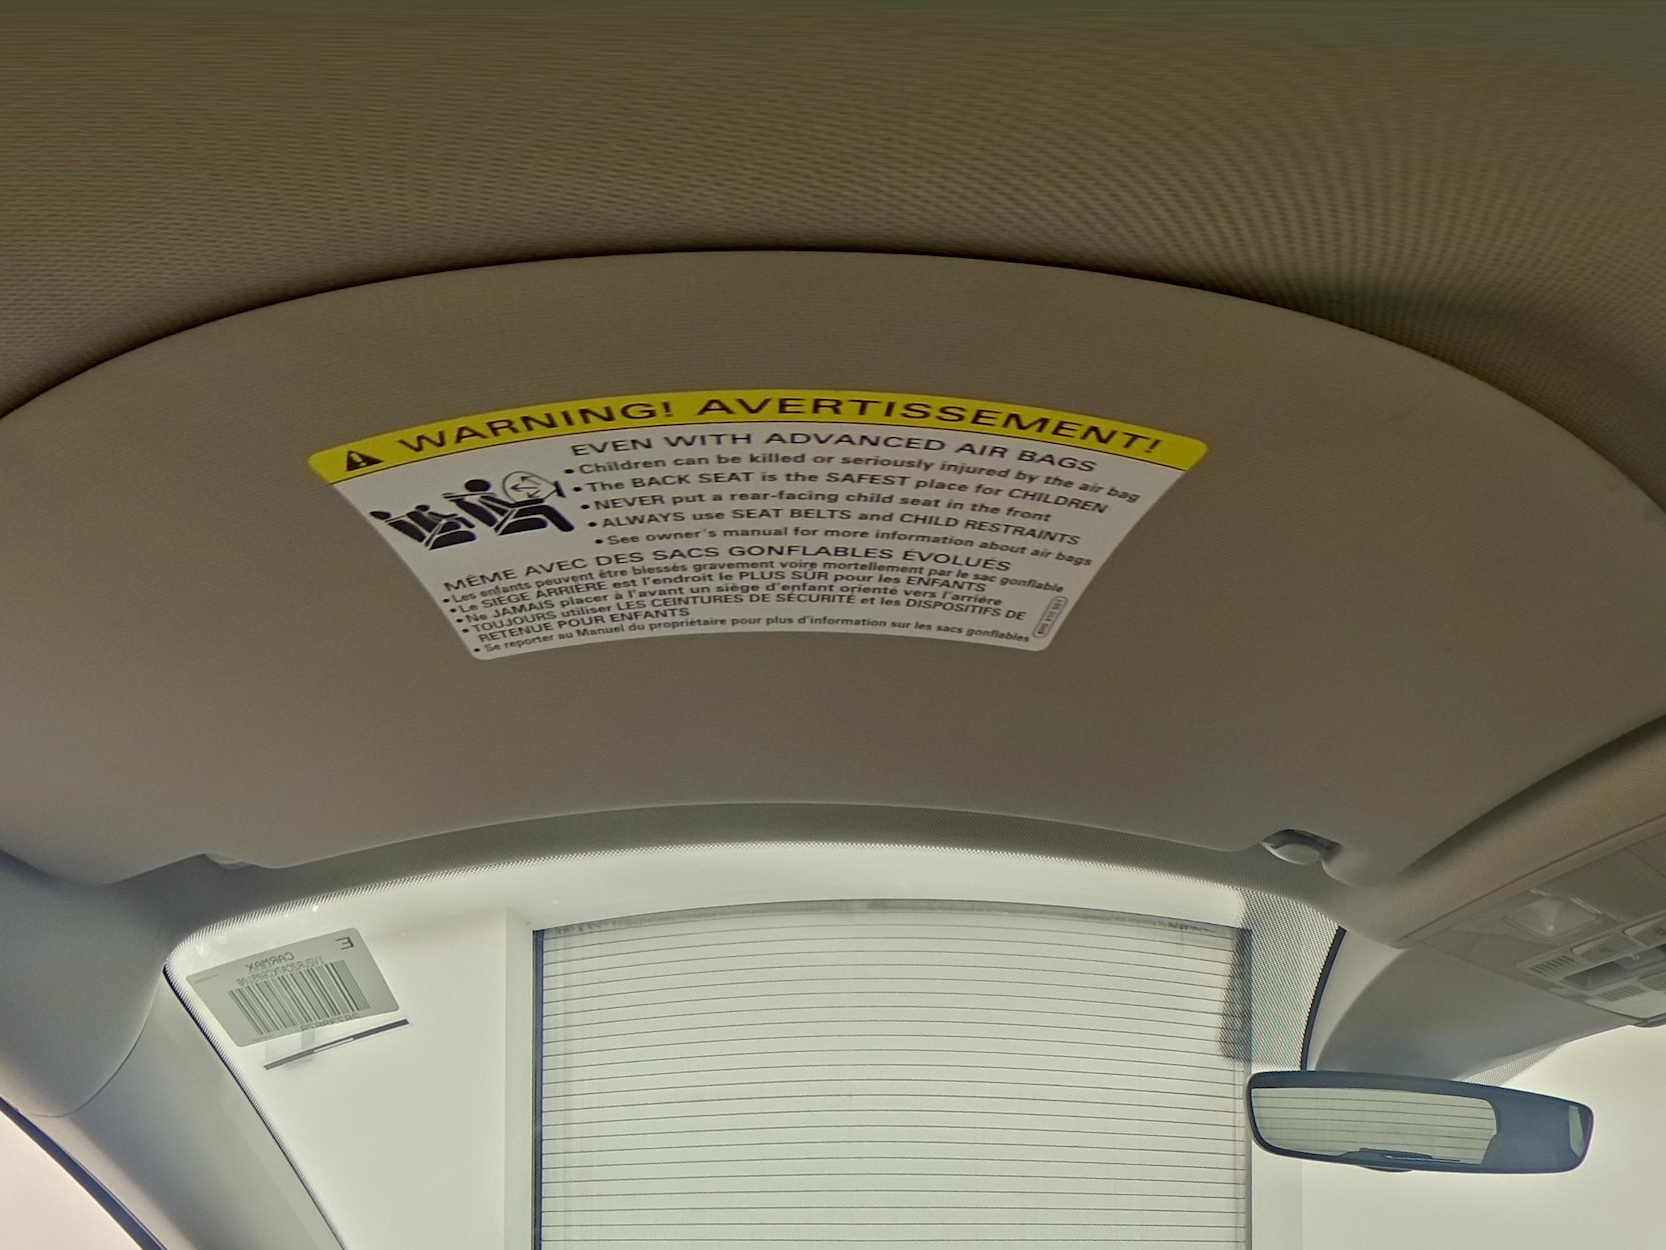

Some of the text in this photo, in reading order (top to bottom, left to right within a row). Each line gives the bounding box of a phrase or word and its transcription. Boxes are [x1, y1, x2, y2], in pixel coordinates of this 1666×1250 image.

[396, 397, 1163, 454] WARNING! AVERTISSEMENT!
[570, 432, 1098, 473] EVEN WITH ADVANCED AIR BAGS
[578, 452, 1141, 504] Children can be killed or seriously injured by the air bag
[583, 471, 1109, 514] The BACK SEAT is the SAFEST place for CHILDREN
[592, 489, 1052, 523] NEVER put a rear-facing child seat in the front
[601, 508, 1081, 546] ALWAYS use SEAT BELTS and CHILD RESTRAINTS
[606, 534, 640, 546] See
[722, 526, 789, 537] manual
[792, 526, 820, 537] for
[823, 529, 870, 539] more
[874, 529, 975, 548] information
[978, 540, 1028, 555] about
[1029, 548, 1053, 559] air
[1054, 551, 1093, 567] bags
[524, 558, 589, 577] AVEC
[594, 551, 645, 567] DES
[651, 546, 720, 561] SACS
[727, 545, 895, 560] GONFLABLES
[450, 592, 478, 604] Les
[479, 582, 533, 598] enfants
[534, 571, 596, 590] peuvent
[691, 560, 775, 573] gravement
[779, 559, 819, 570] voire
[822, 561, 925, 575] mortellement
[926, 568, 954, 577] par
[955, 568, 970, 579] le
[972, 573, 998, 583] sac
[998, 576, 1064, 593] gonflable
[457, 604, 479, 614] Le
[611, 578, 639, 589] est
[718, 571, 734, 582] le
[738, 570, 787, 581] PLUS
[833, 573, 875, 583] pour
[877, 573, 902, 585] les
[905, 575, 987, 593] ENFANTS
[464, 613, 489, 624] Ne
[492, 599, 556, 619] JAMAIS
[558, 594, 609, 609] placer
[689, 586, 711, 594] un
[903, 589, 937, 599] vers
[470, 610, 558, 633] TOUJOURS
[560, 605, 613, 618] utiliser
[615, 599, 647, 612] LES
[649, 593, 745, 608] CEINTURES
[748, 593, 771, 603] DE
[859, 596, 876, 605] et
[879, 596, 902, 607] les
[905, 598, 1002, 617] DISPOSITIFS
[1004, 609, 1027, 621] DE
[477, 607, 691, 643] RETENUE POUR ENFANTS
[483, 643, 502, 653] Se
[503, 634, 554, 649] reporter
[557, 632, 574, 640] au
[575, 623, 625, 638] Manuel
[627, 622, 646, 632] du
[730, 617, 762, 627] pour
[765, 615, 794, 627] plus
[890, 621, 912, 629] sur
[913, 621, 932, 631] les
[935, 624, 964, 634] sacs
[965, 628, 1030, 643] gonflables
